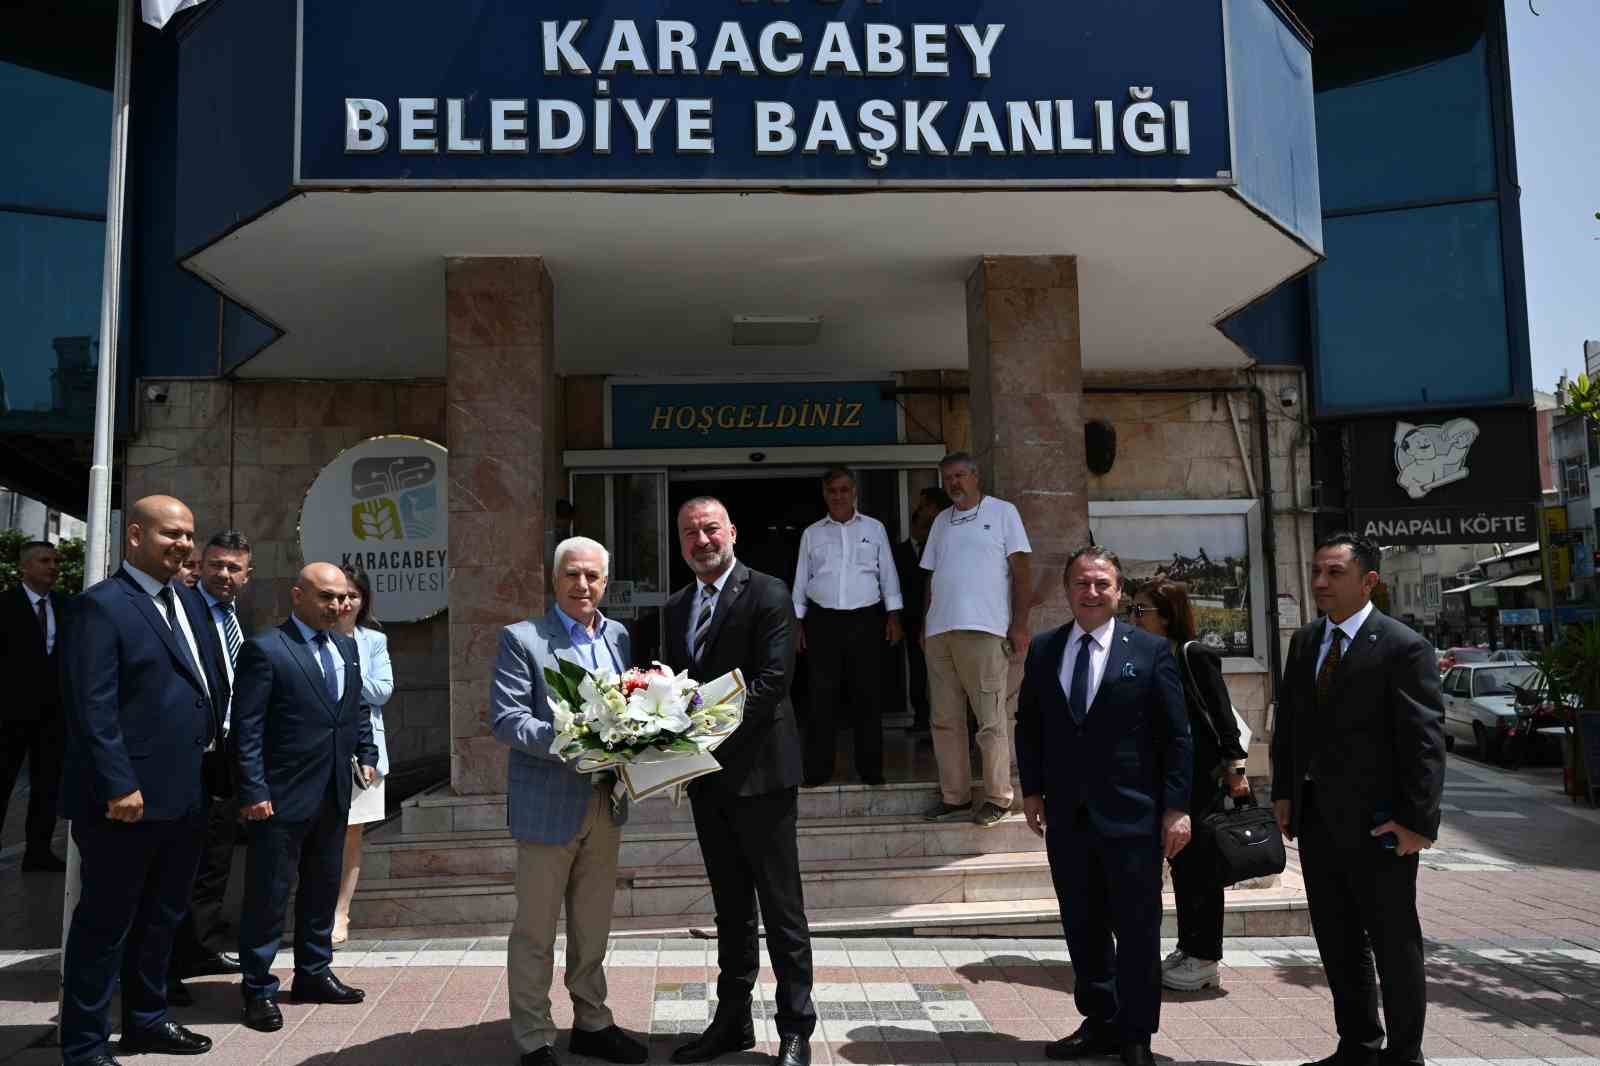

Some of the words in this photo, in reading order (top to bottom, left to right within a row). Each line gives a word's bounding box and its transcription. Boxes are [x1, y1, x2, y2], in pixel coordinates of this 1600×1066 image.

[541, 19, 1005, 77] KARACABEY
[344, 79, 714, 154] BELEDİYE
[754, 86, 1191, 168] BAŞKANLIĞI
[651, 398, 864, 435] HOŞGELDİNİZ
[1364, 516, 1451, 537] ANAPALI
[1459, 512, 1527, 533] KÖFTE
[341, 550, 447, 570] KARACABEY
